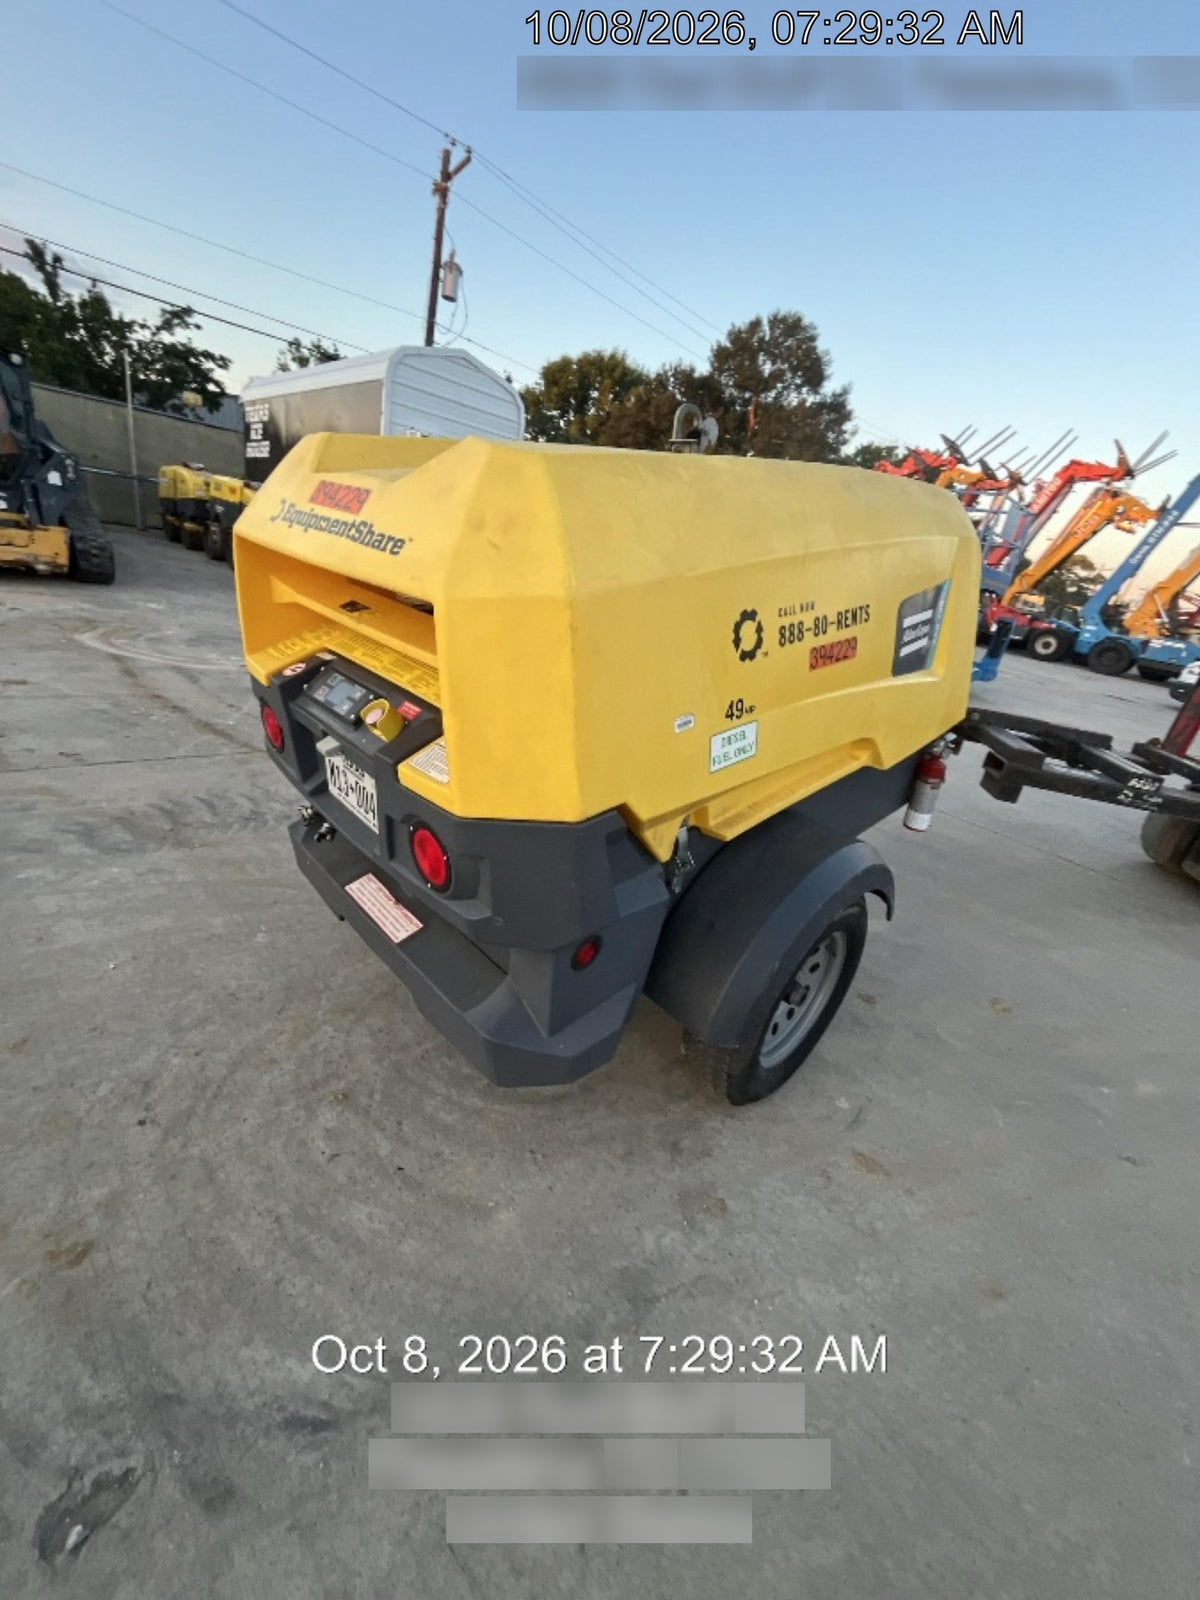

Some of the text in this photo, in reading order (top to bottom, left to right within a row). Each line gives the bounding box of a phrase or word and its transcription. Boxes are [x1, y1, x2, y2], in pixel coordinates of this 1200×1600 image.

[282, 502, 406, 556] EquipmentShare
[778, 604, 871, 648] 888-80-RENTS
[809, 635, 858, 671] 394229
